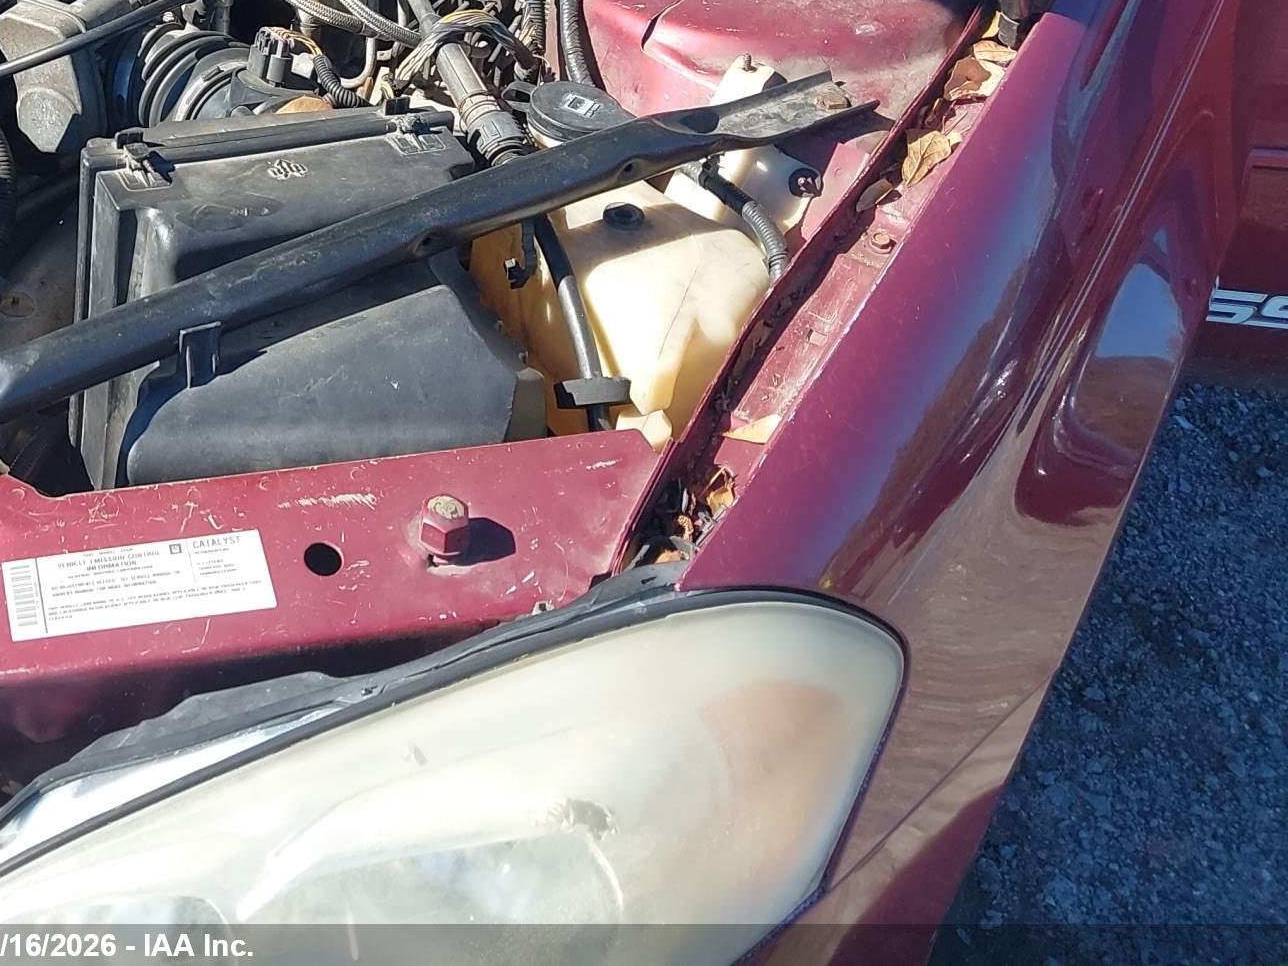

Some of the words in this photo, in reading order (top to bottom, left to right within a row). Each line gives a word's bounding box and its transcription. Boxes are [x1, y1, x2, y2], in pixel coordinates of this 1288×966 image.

[192, 535, 243, 549] CATALYST
[85, 559, 138, 571] INFORMATION
[88, 554, 126, 566] EMISSION
